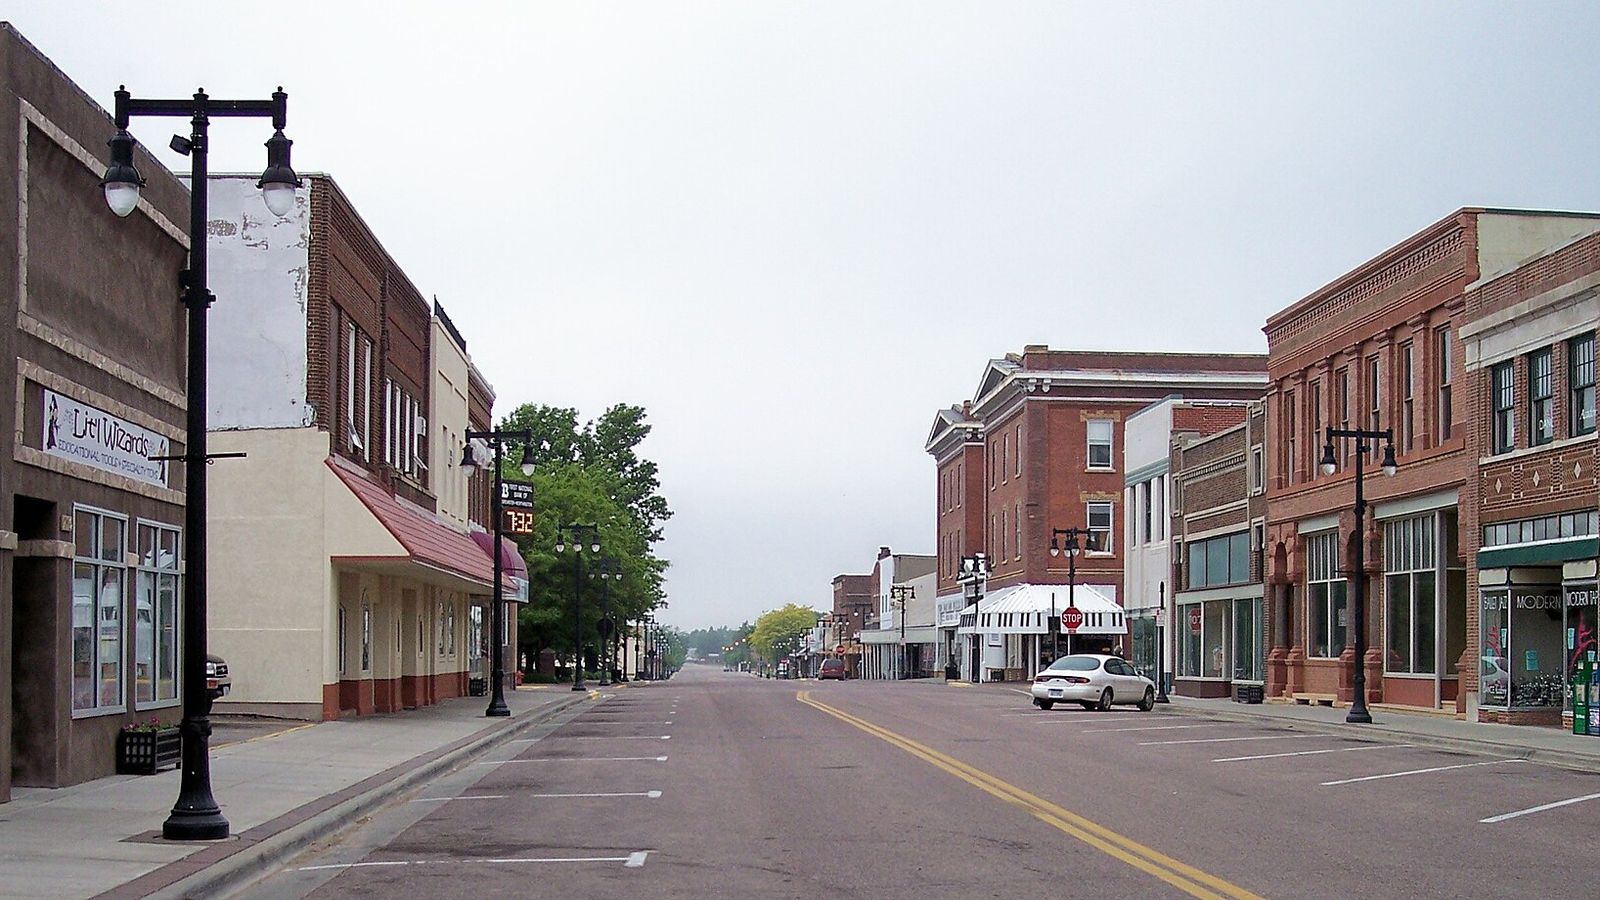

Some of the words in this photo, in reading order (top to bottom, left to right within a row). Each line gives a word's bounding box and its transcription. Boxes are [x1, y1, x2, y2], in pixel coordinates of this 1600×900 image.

[103, 417, 149, 457] Wizards
[507, 511, 533, 533] 7:32
[1516, 595, 1561, 609] MODERN
[1063, 613, 1082, 623] STOP
